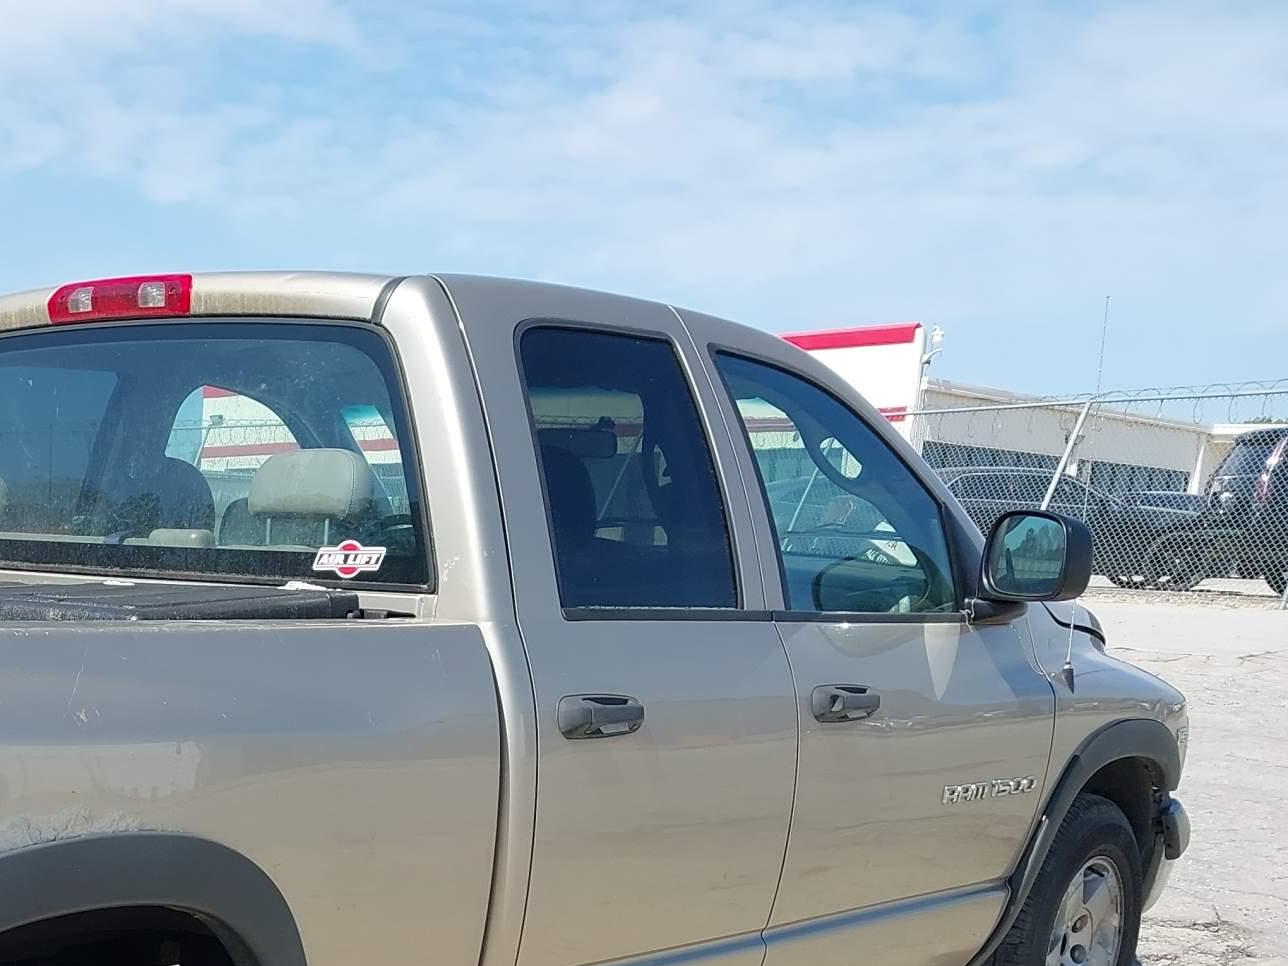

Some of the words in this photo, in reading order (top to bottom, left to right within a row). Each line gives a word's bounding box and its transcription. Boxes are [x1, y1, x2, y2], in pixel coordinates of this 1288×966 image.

[317, 553, 345, 565] AIR
[346, 553, 381, 565] LIFT
[942, 782, 988, 803] RAM
[991, 776, 1037, 797] 1500
